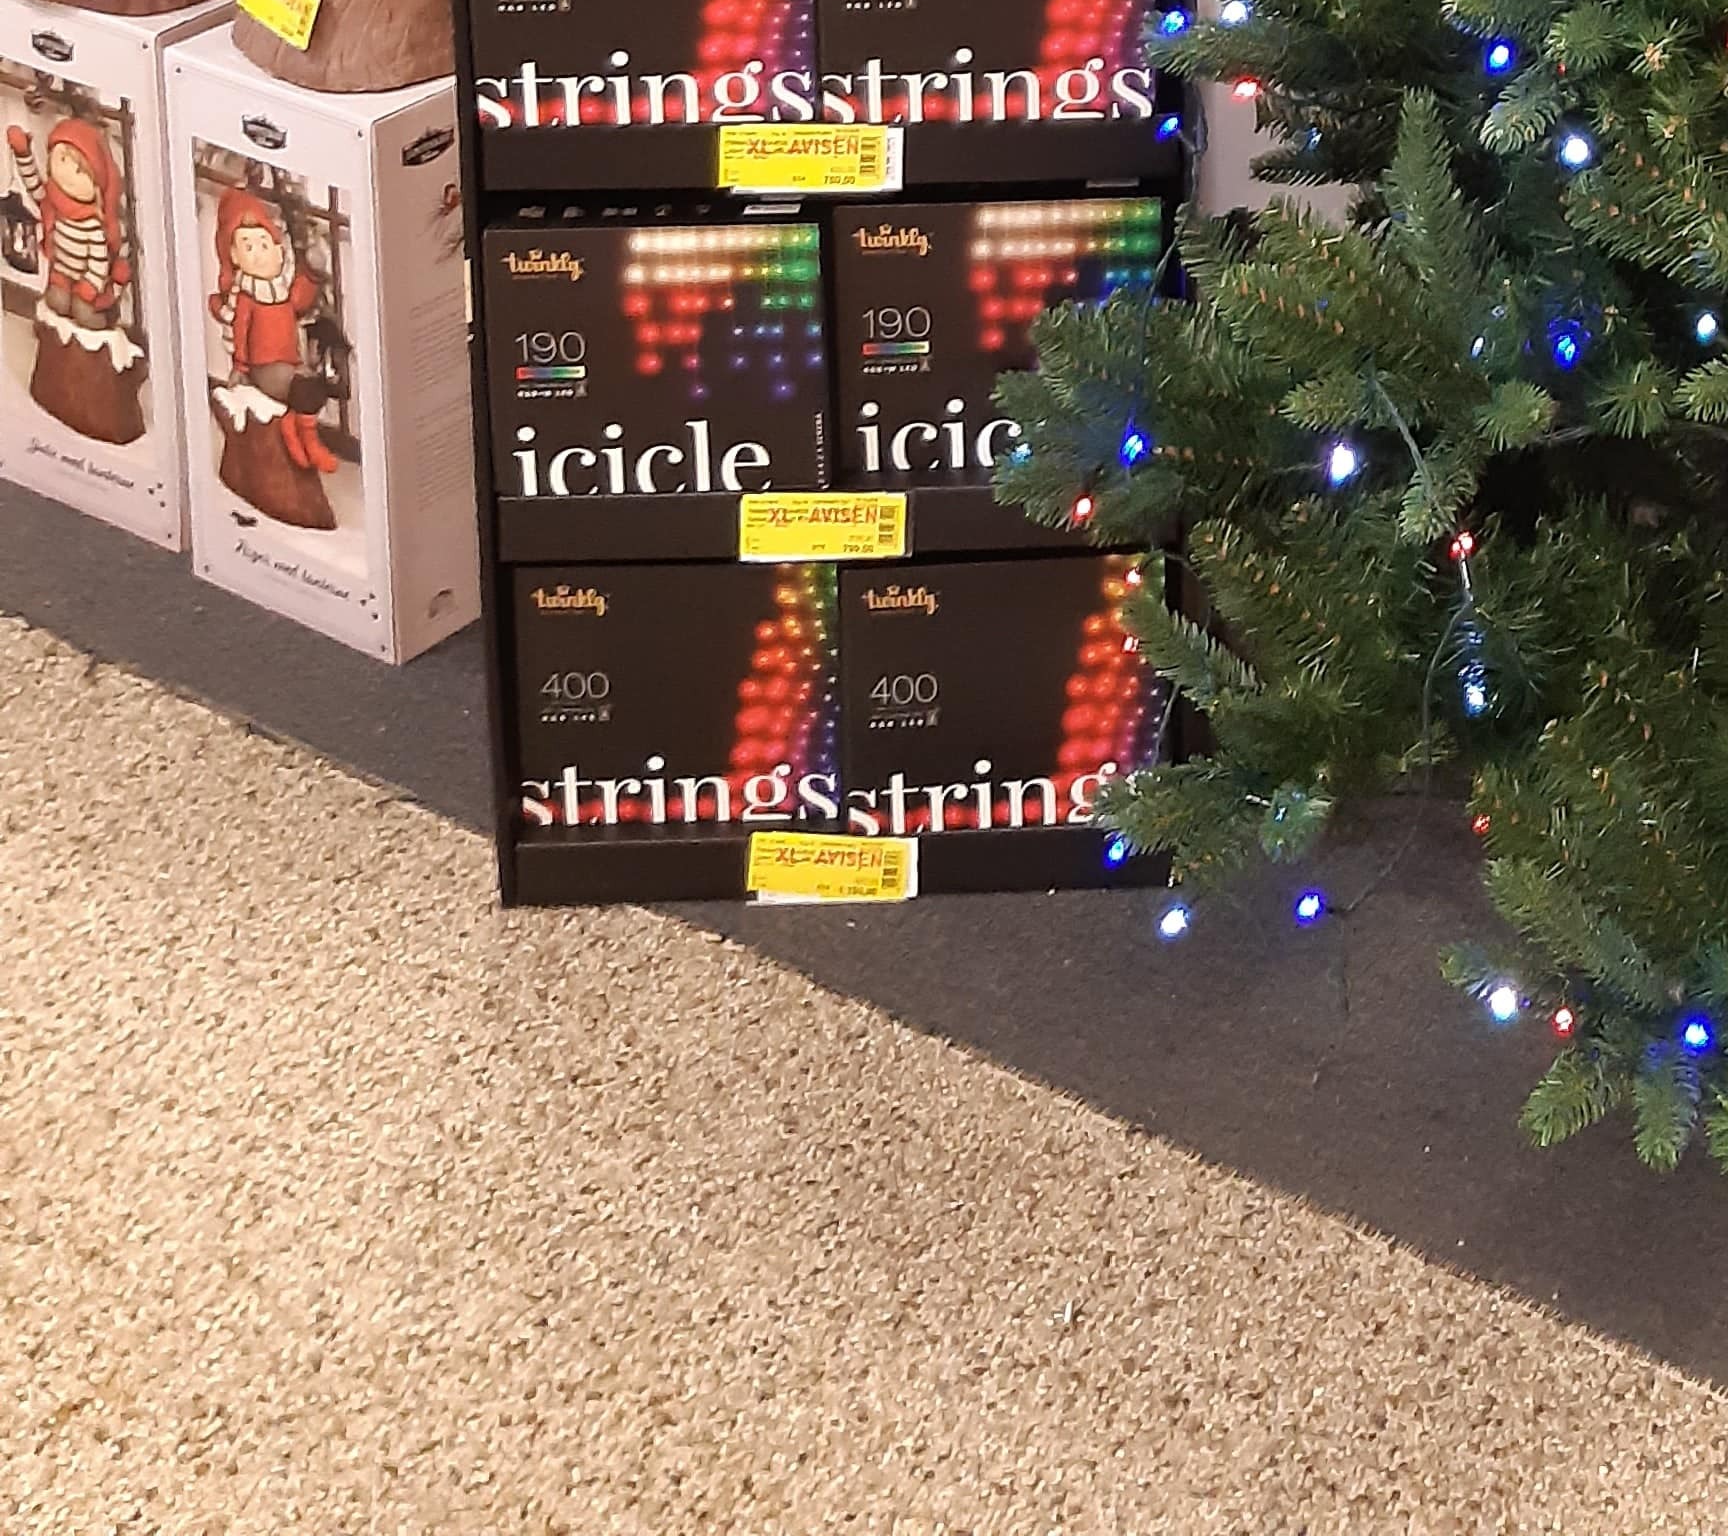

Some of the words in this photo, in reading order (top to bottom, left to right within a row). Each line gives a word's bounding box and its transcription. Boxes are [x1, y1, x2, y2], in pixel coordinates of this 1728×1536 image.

[476, 49, 816, 128] strings
[821, 47, 1153, 123] strings
[851, 224, 933, 256] twinkly
[501, 248, 584, 281] twinkly
[862, 306, 931, 339] 190
[514, 331, 586, 363] 190
[856, 398, 1022, 471] icic
[513, 420, 773, 496] icicle
[861, 585, 939, 615] twinkly
[540, 672, 610, 699] 400
[869, 673, 938, 704] 400
[521, 755, 840, 827] strings
[847, 759, 1118, 836] string
